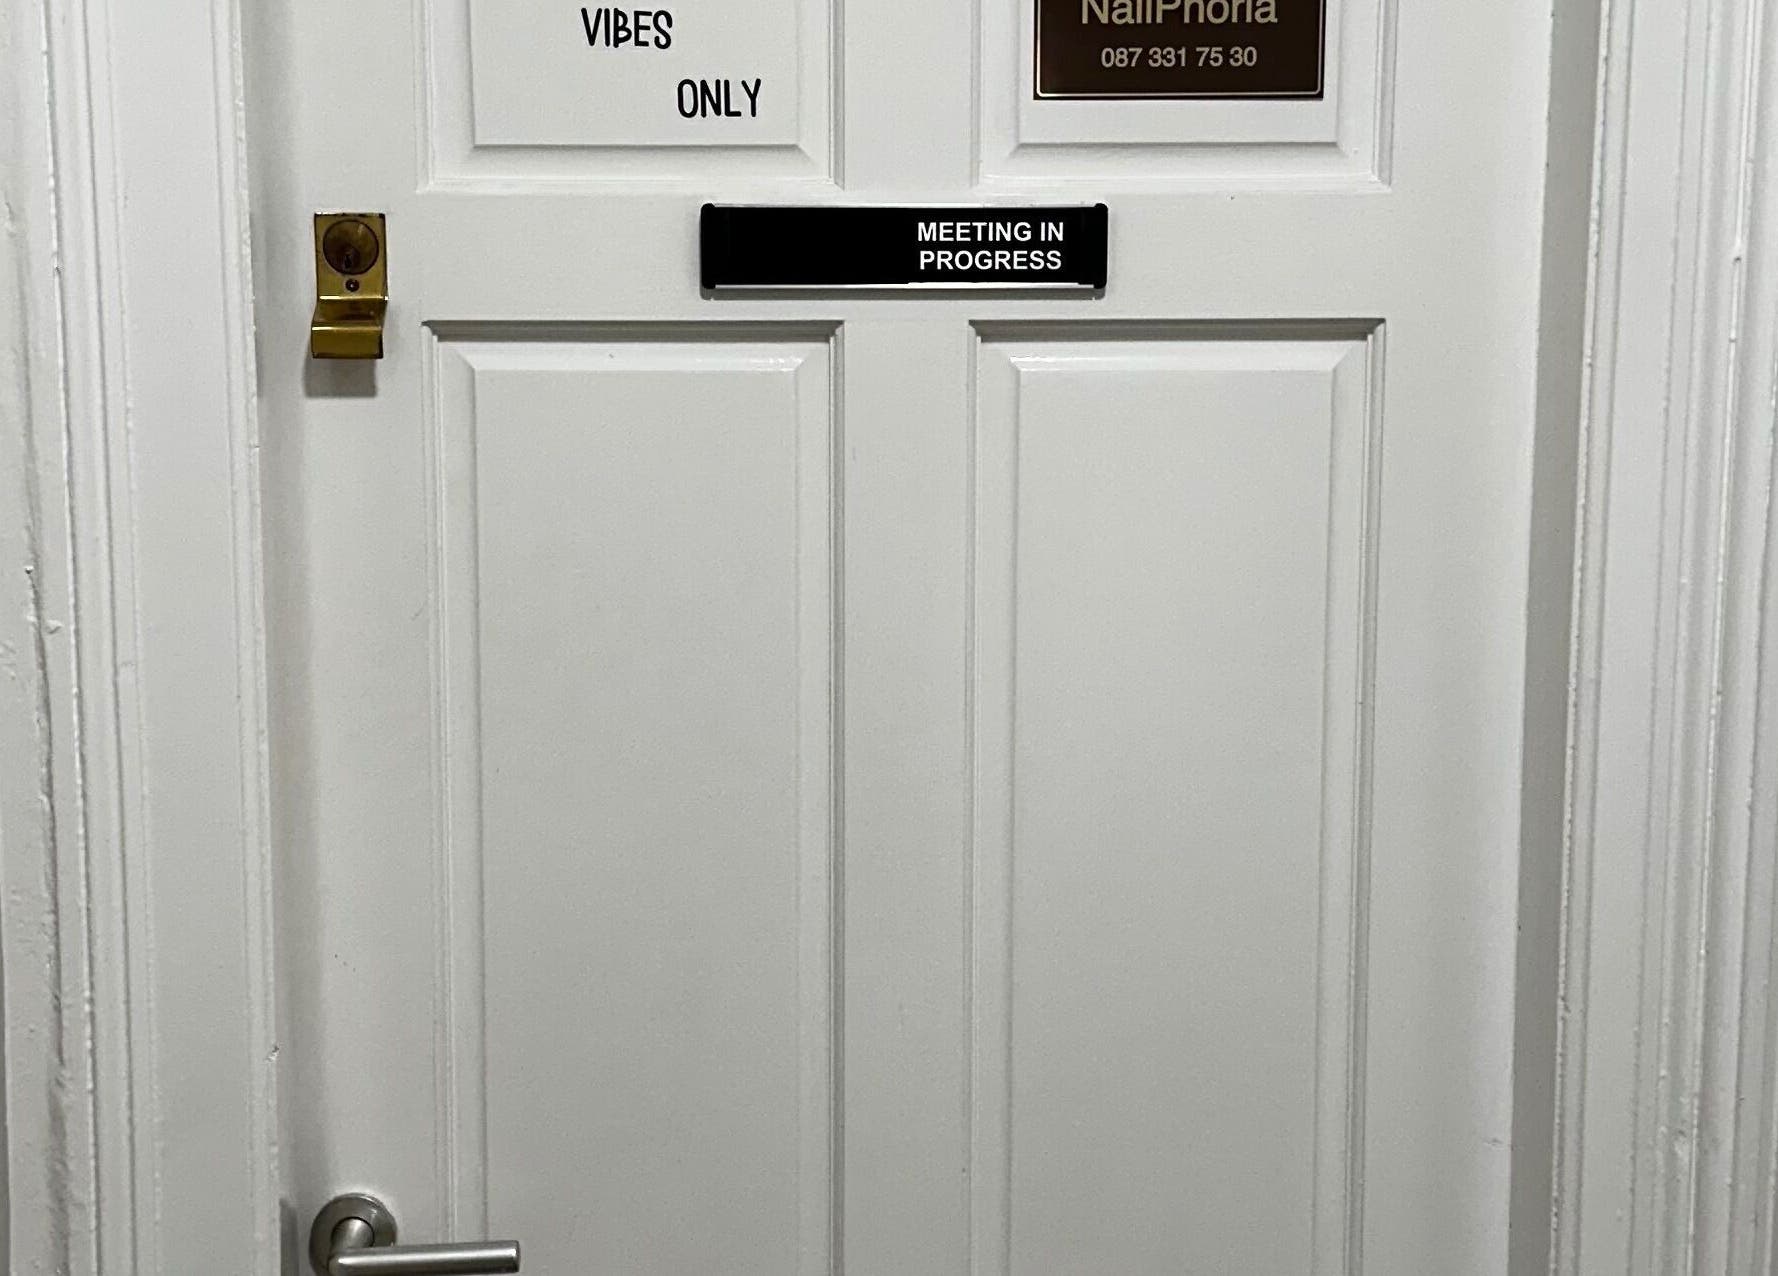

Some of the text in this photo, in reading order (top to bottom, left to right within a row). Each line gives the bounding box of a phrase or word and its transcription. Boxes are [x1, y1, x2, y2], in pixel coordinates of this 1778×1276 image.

[580, 8, 673, 49] VIBES
[1101, 46, 1257, 68] 087 331 75 30
[677, 78, 762, 118] ONLY
[917, 221, 1064, 242] MEETING IN
[919, 250, 1062, 270] PROGRESS
